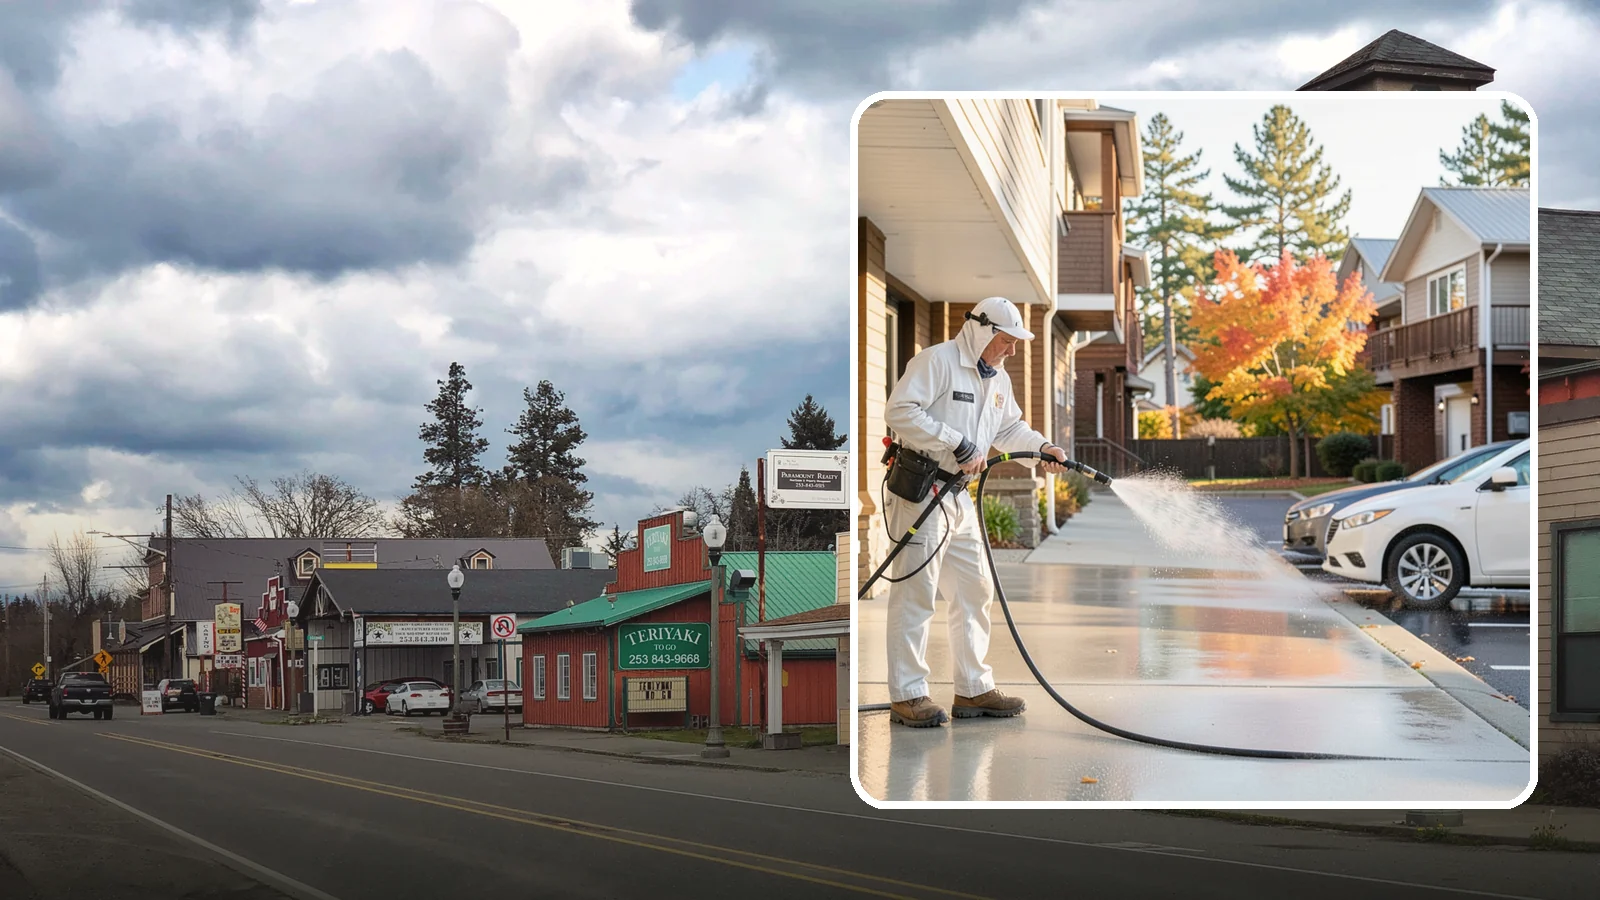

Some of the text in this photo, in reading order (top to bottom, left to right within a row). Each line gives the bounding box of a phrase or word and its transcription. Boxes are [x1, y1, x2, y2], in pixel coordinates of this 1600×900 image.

[817, 472, 838, 480] REALTY
[624, 627, 702, 646] TERIYAKI
[629, 654, 700, 664] 253 843-9668
